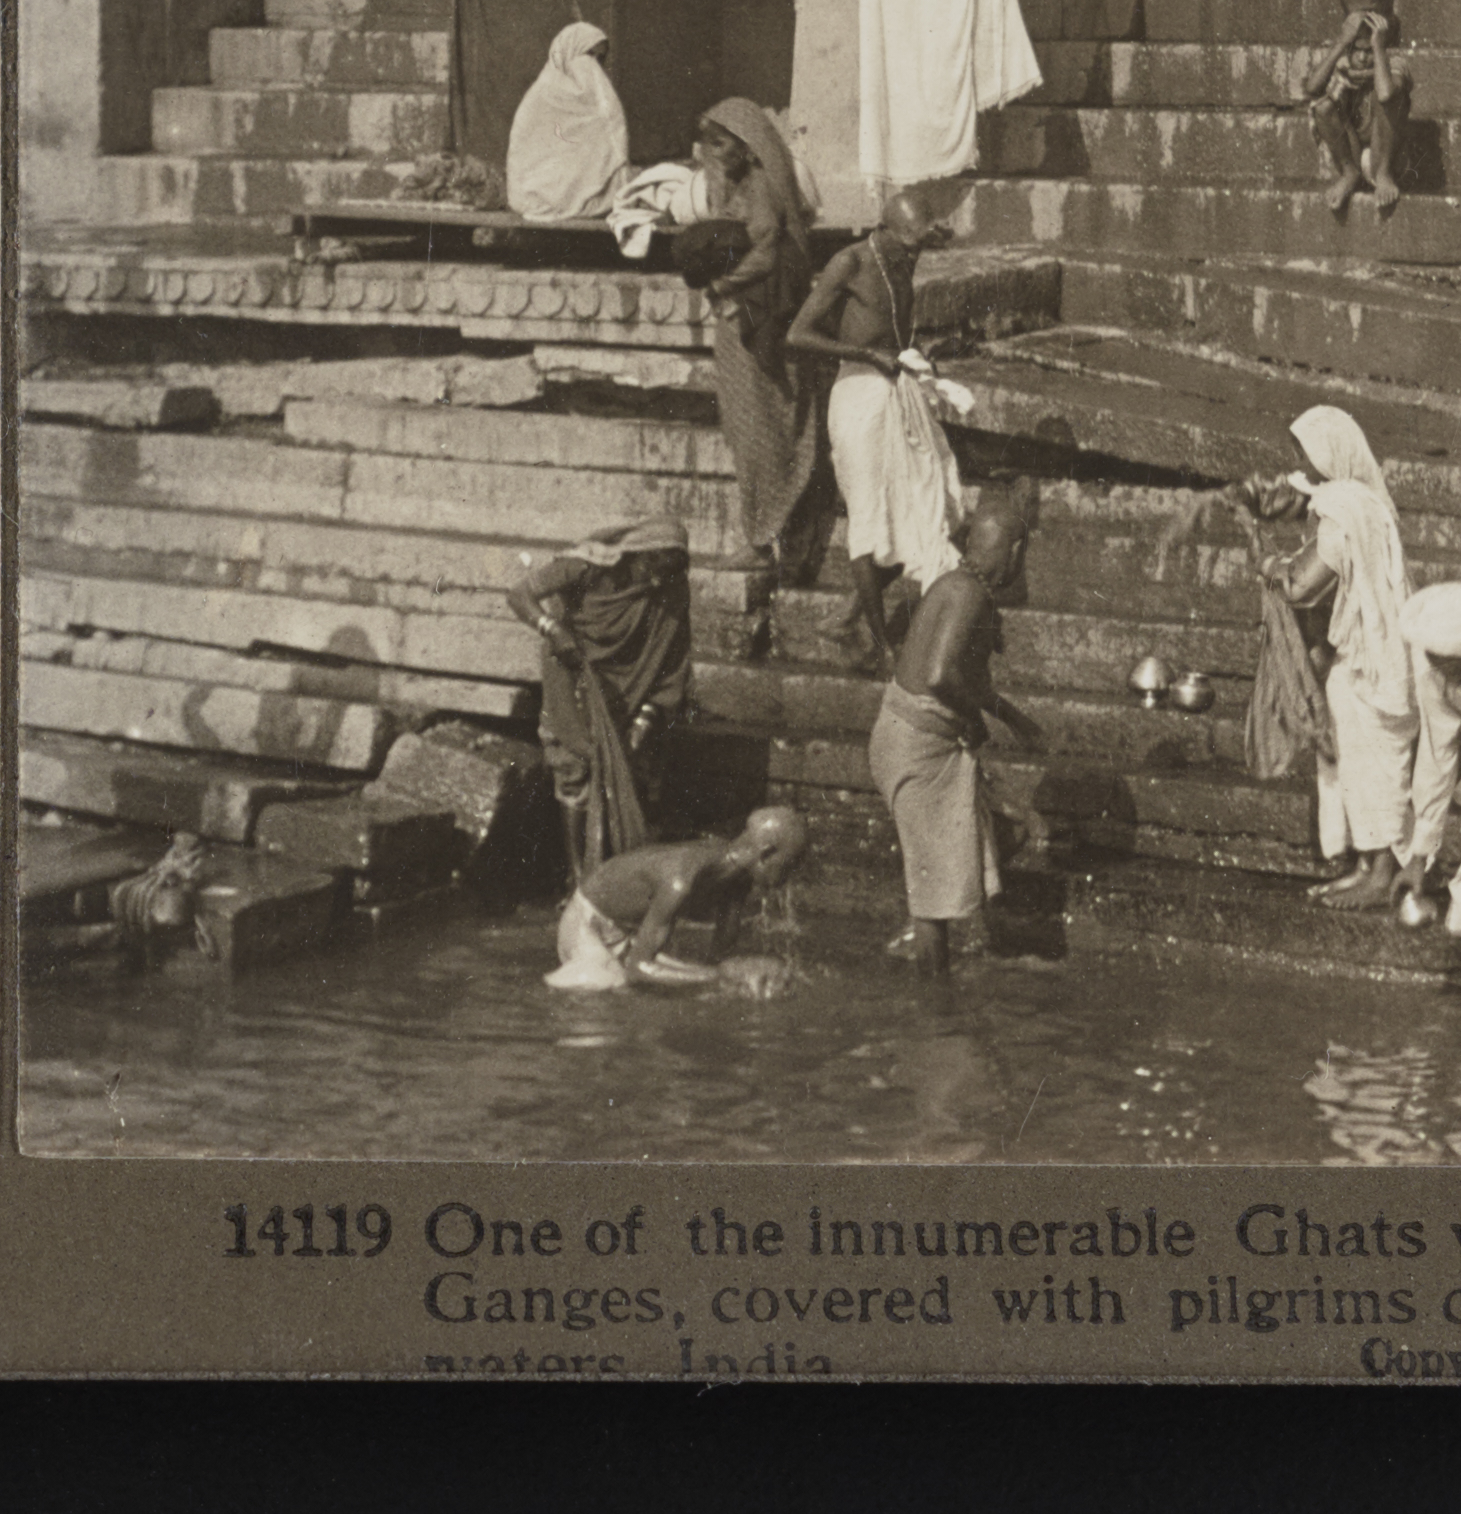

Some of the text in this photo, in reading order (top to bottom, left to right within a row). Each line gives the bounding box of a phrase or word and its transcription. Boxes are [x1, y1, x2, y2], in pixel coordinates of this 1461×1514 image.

[223, 1202, 393, 1259] 14119
[423, 1202, 563, 1259] One
[584, 1204, 645, 1257] of
[685, 1207, 785, 1257] the
[808, 1206, 1196, 1258] innumerable
[1236, 1204, 1428, 1258] Ghats
[423, 1270, 686, 1332] Ganges,
[711, 1275, 953, 1324] covered
[992, 1274, 1127, 1324] with
[1169, 1275, 1417, 1333] pilgrims
